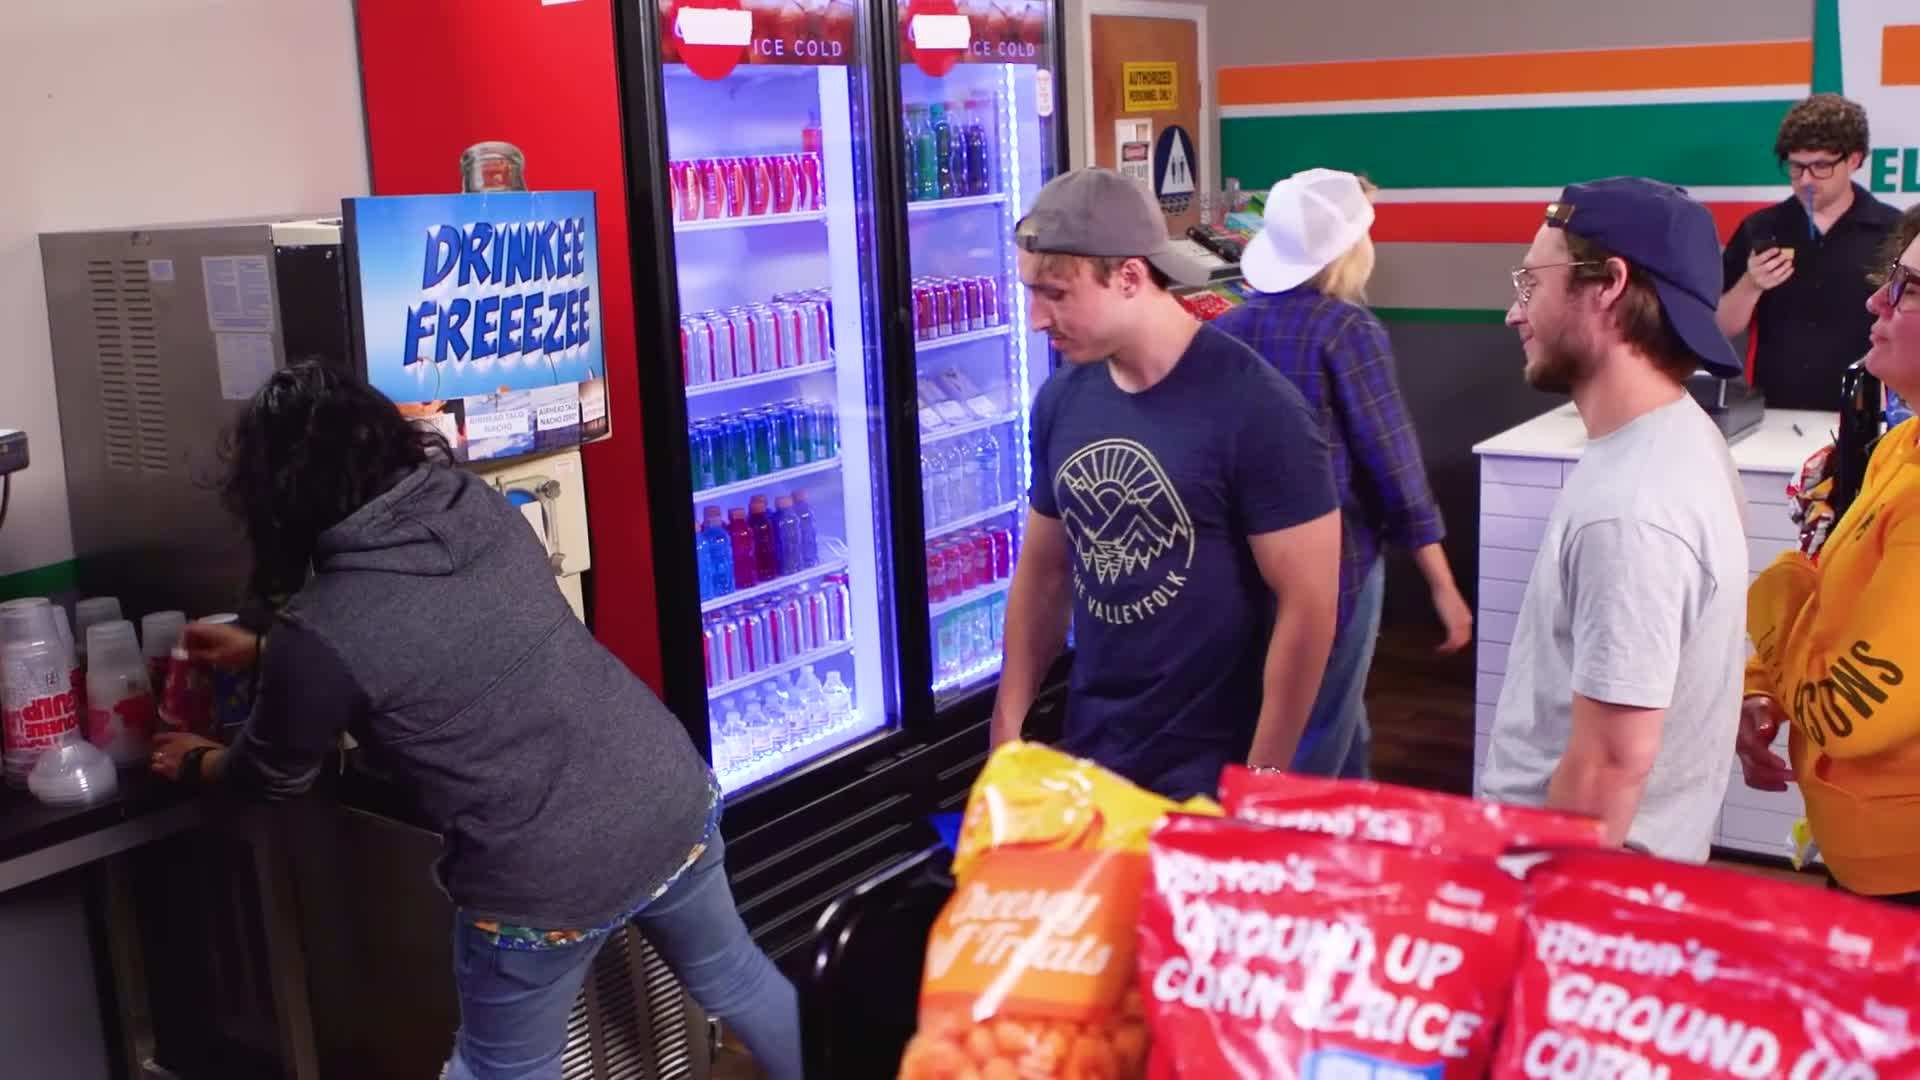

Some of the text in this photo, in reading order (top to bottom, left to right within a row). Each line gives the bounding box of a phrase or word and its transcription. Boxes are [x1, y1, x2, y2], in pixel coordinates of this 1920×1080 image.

[752, 39, 842, 56] ICE COLD
[998, 42, 1035, 57] COLD
[422, 217, 585, 290] DRINKEE
[403, 286, 590, 366] FREEEZEE
[1087, 570, 1188, 625] VALLEYFOLK
[972, 922, 1113, 976] Trats
[1384, 933, 1464, 991] UP
[1536, 920, 1724, 982] Horton's
[1153, 956, 1290, 1021] CORN
[1352, 983, 1484, 1058] RICE
[1547, 973, 1781, 1080] GROUND
